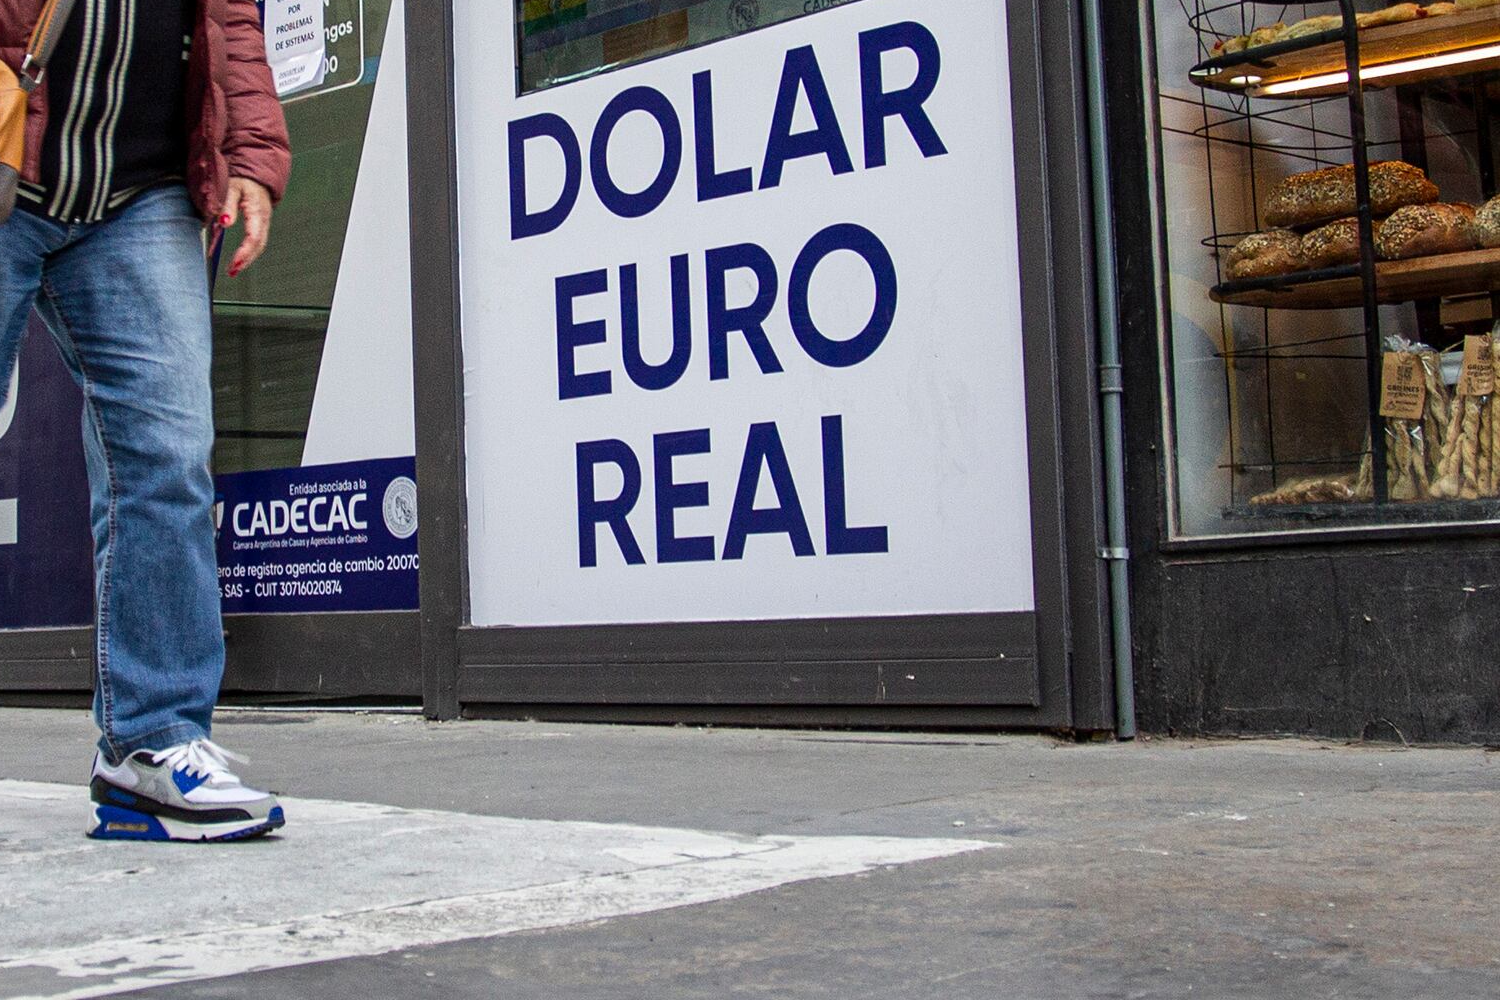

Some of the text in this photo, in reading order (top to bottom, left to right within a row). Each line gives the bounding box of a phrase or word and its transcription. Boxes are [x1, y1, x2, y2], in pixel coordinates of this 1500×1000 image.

[287, 3, 301, 15] POR
[275, 15, 313, 35] PROBLEMAS
[275, 31, 315, 51] DE SISTEMAS
[507, 20, 949, 240] DOLAR
[555, 222, 898, 401] EURO
[289, 479, 367, 496] Entidad asociada a la
[576, 415, 889, 568] REAL
[233, 493, 368, 537] CADECAC
[254, 539, 281, 551] Argentina
[281, 538, 288, 547] de
[289, 537, 306, 548] Casas
[310, 536, 336, 549] Agencias
[337, 535, 345, 545] de
[345, 534, 368, 545] Cambio
[233, 564, 246, 577] de
[247, 561, 284, 580] registro
[285, 559, 327, 578] agencia
[328, 558, 343, 573] de
[345, 556, 384, 572] cambio
[224, 583, 243, 598] SAS
[254, 582, 278, 597] CUIT
[279, 580, 342, 597] 30716020874
